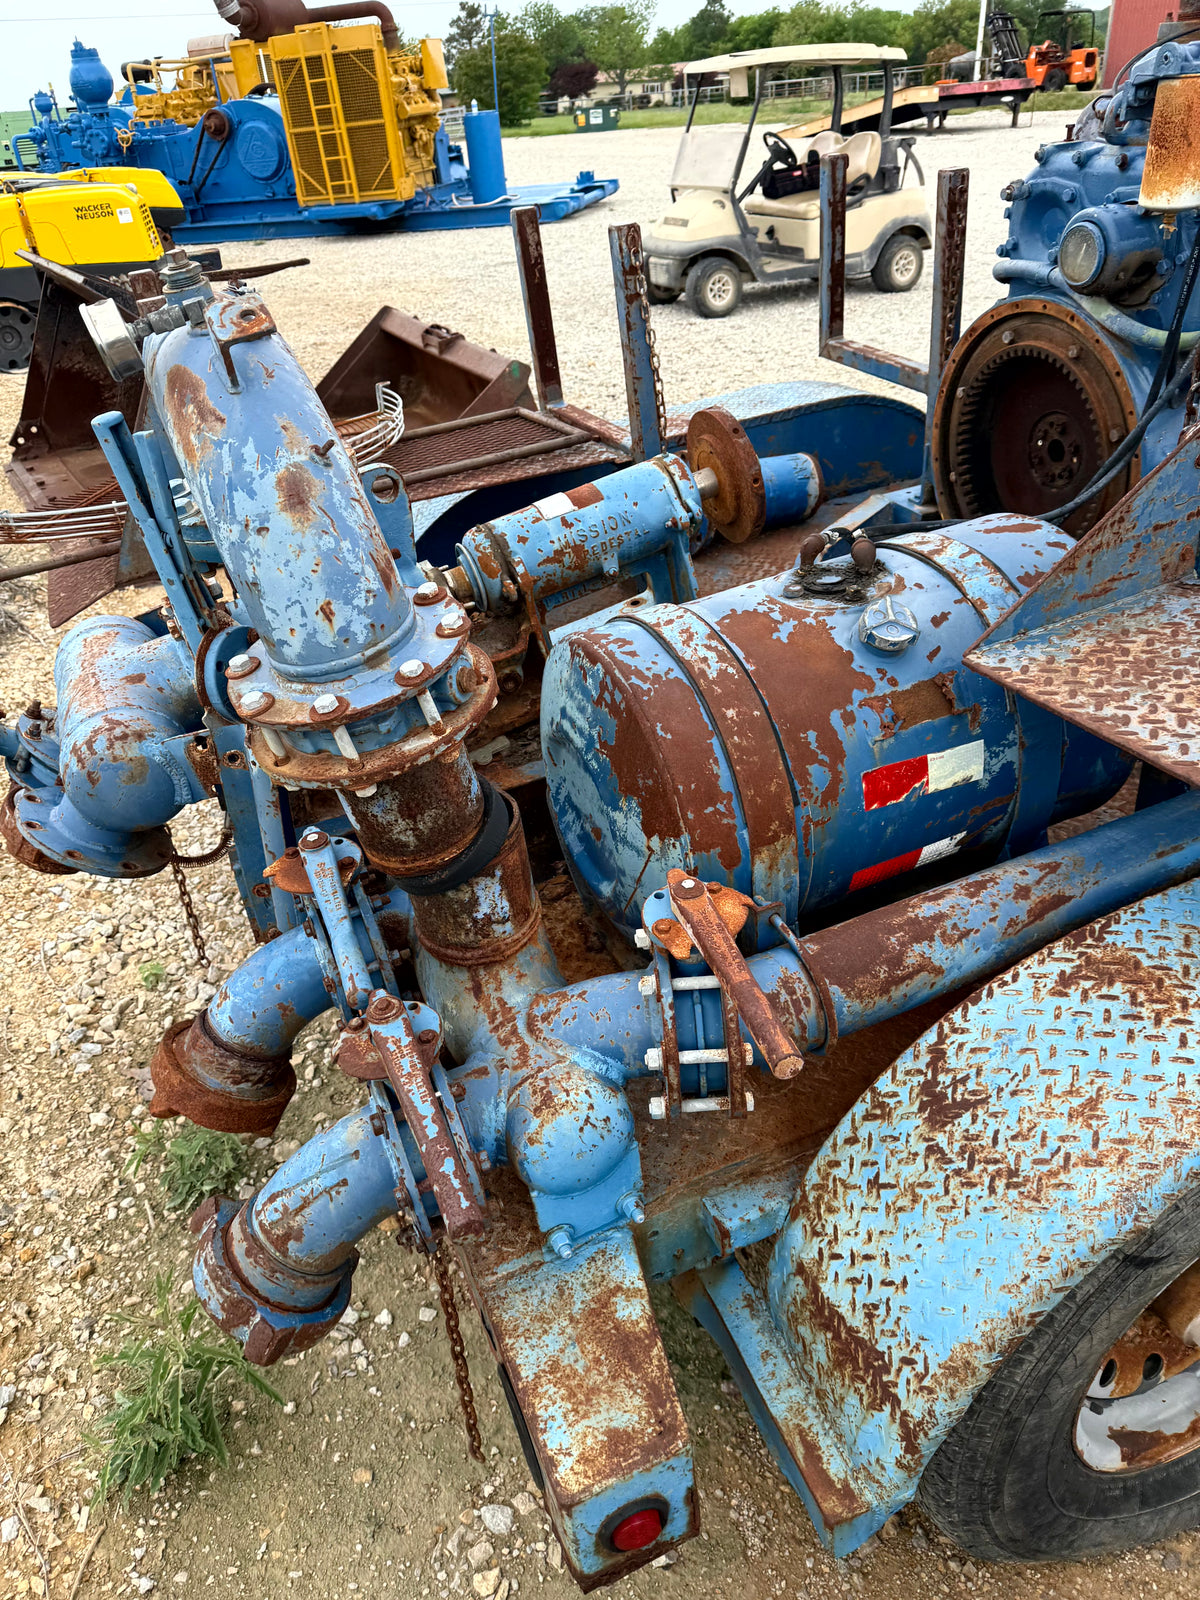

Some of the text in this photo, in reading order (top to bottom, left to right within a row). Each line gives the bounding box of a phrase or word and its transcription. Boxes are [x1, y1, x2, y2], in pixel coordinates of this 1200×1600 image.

[73, 203, 112, 213] WACKER
[76, 210, 114, 220] NEUSON
[557, 511, 632, 552] MISSION
